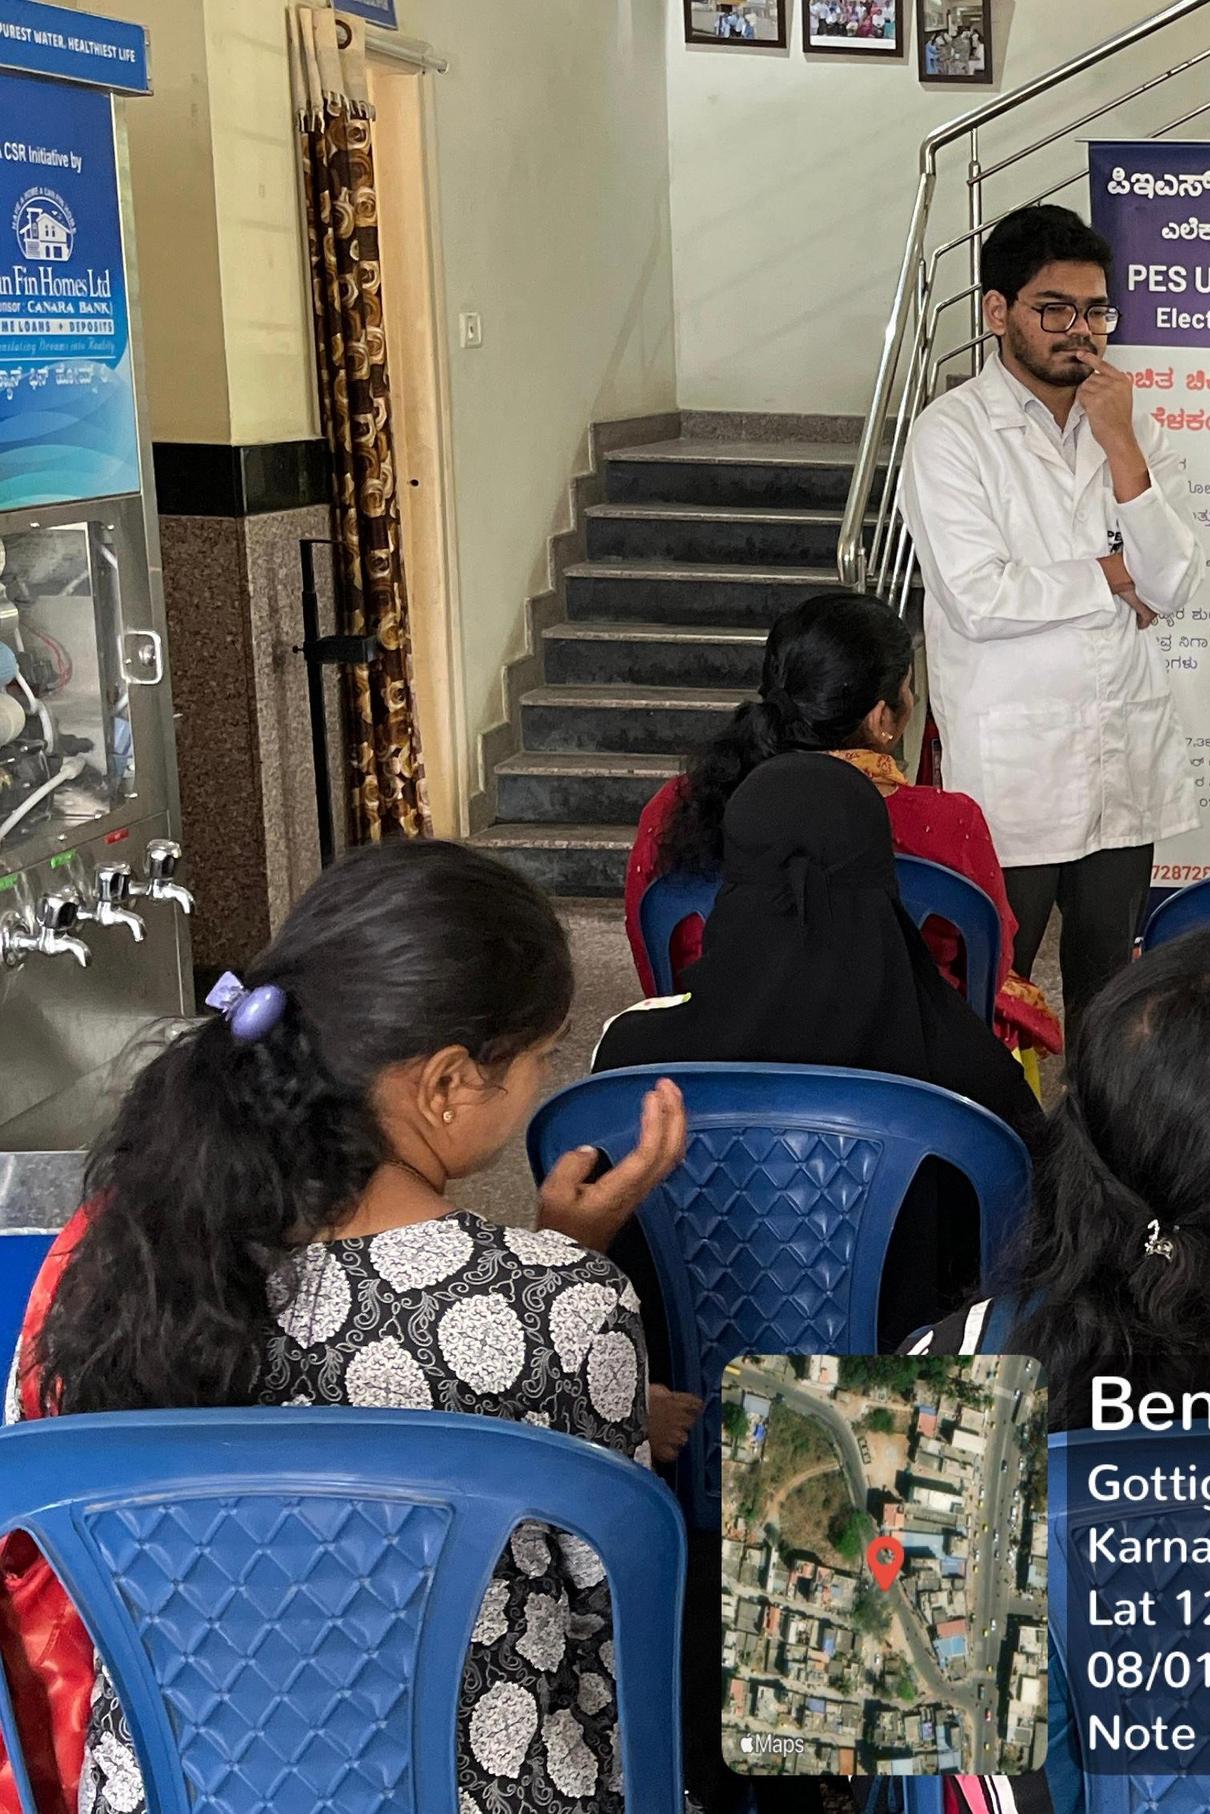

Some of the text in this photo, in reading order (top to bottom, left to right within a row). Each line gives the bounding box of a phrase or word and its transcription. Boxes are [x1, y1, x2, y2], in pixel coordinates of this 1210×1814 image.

[68, 37, 116, 58] HEALTHIEST
[119, 47, 136, 62] LIFE
[4, 142, 82, 173] CSR Initiative by
[13, 265, 38, 296] Fin
[38, 266, 87, 297] Homes
[87, 268, 111, 298] Ltd
[1128, 264, 1187, 293] PES
[27, 301, 75, 313] CANARA
[20, 321, 50, 333] LOANS
[69, 321, 113, 333] DEPOSITS
